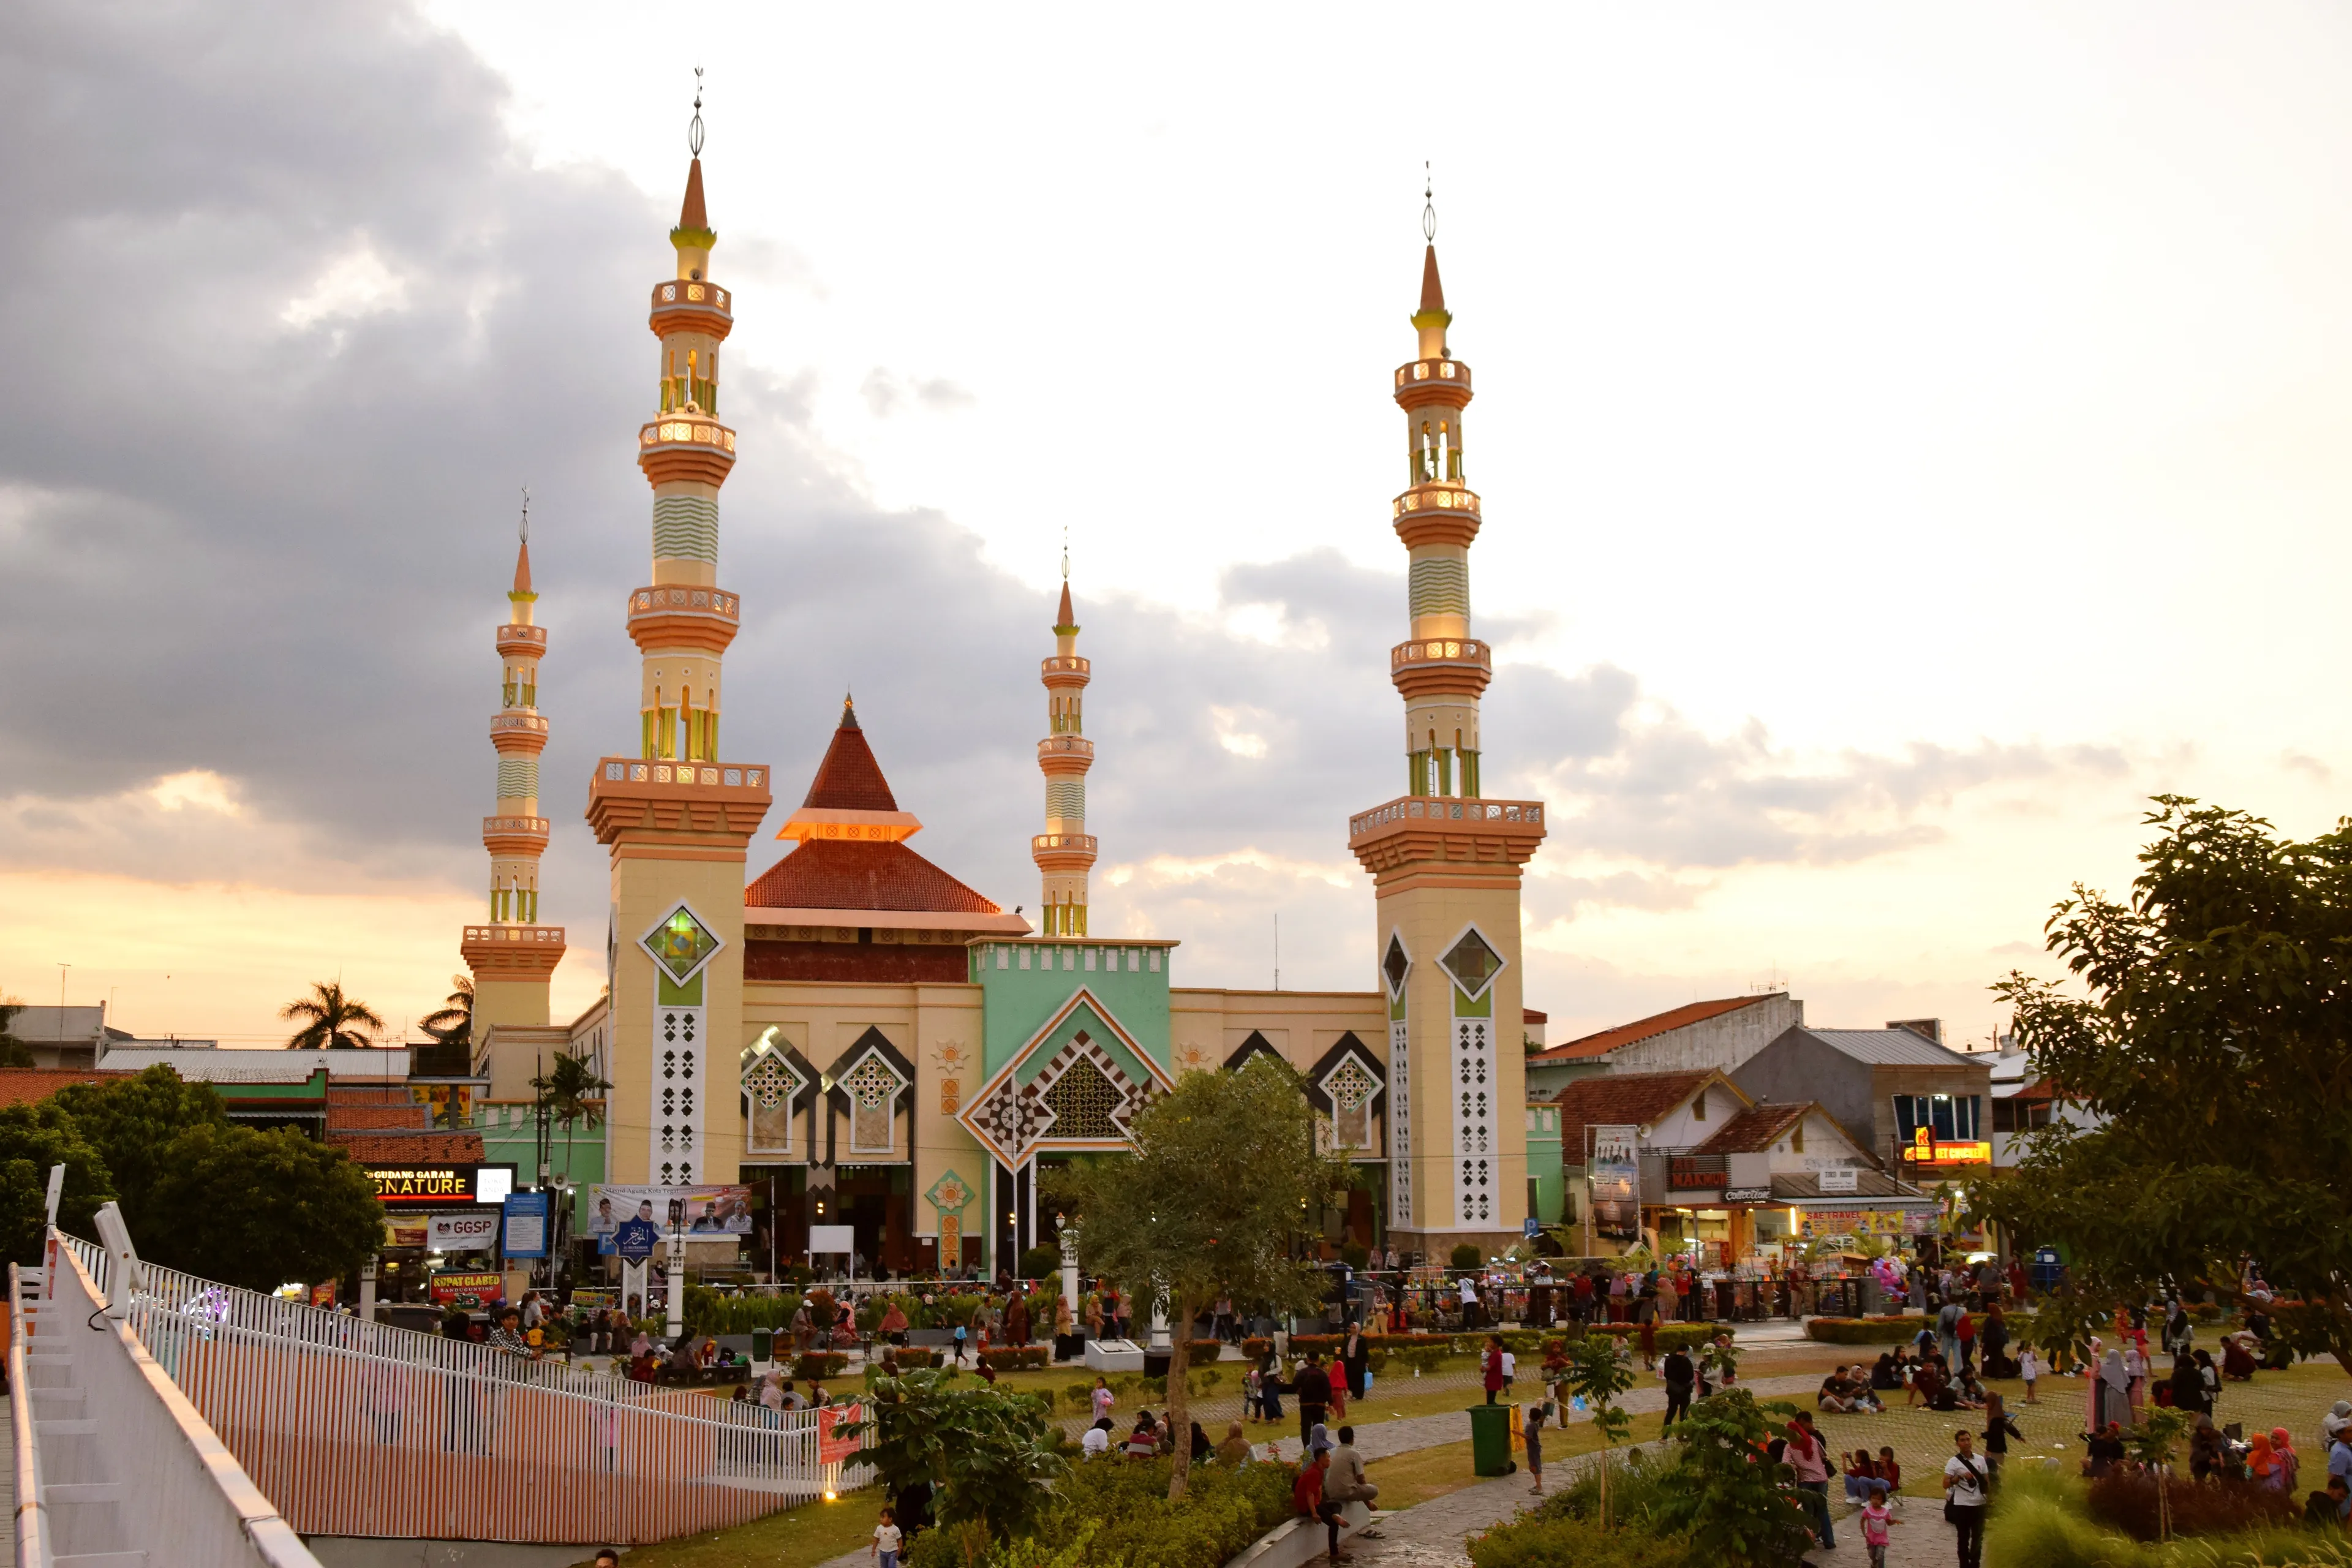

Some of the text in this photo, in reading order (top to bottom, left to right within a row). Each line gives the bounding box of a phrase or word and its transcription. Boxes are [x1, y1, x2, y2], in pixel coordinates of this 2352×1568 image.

[374, 1170, 454, 1179] GUDANG GARAM
[1672, 1172, 1727, 1187] MAKMUR
[374, 1178, 466, 1194] GNATURE
[1806, 1211, 1862, 1220] SAE TRAVEL
[454, 1221, 492, 1234] GGSP
[433, 1276, 464, 1287] KUPAT
